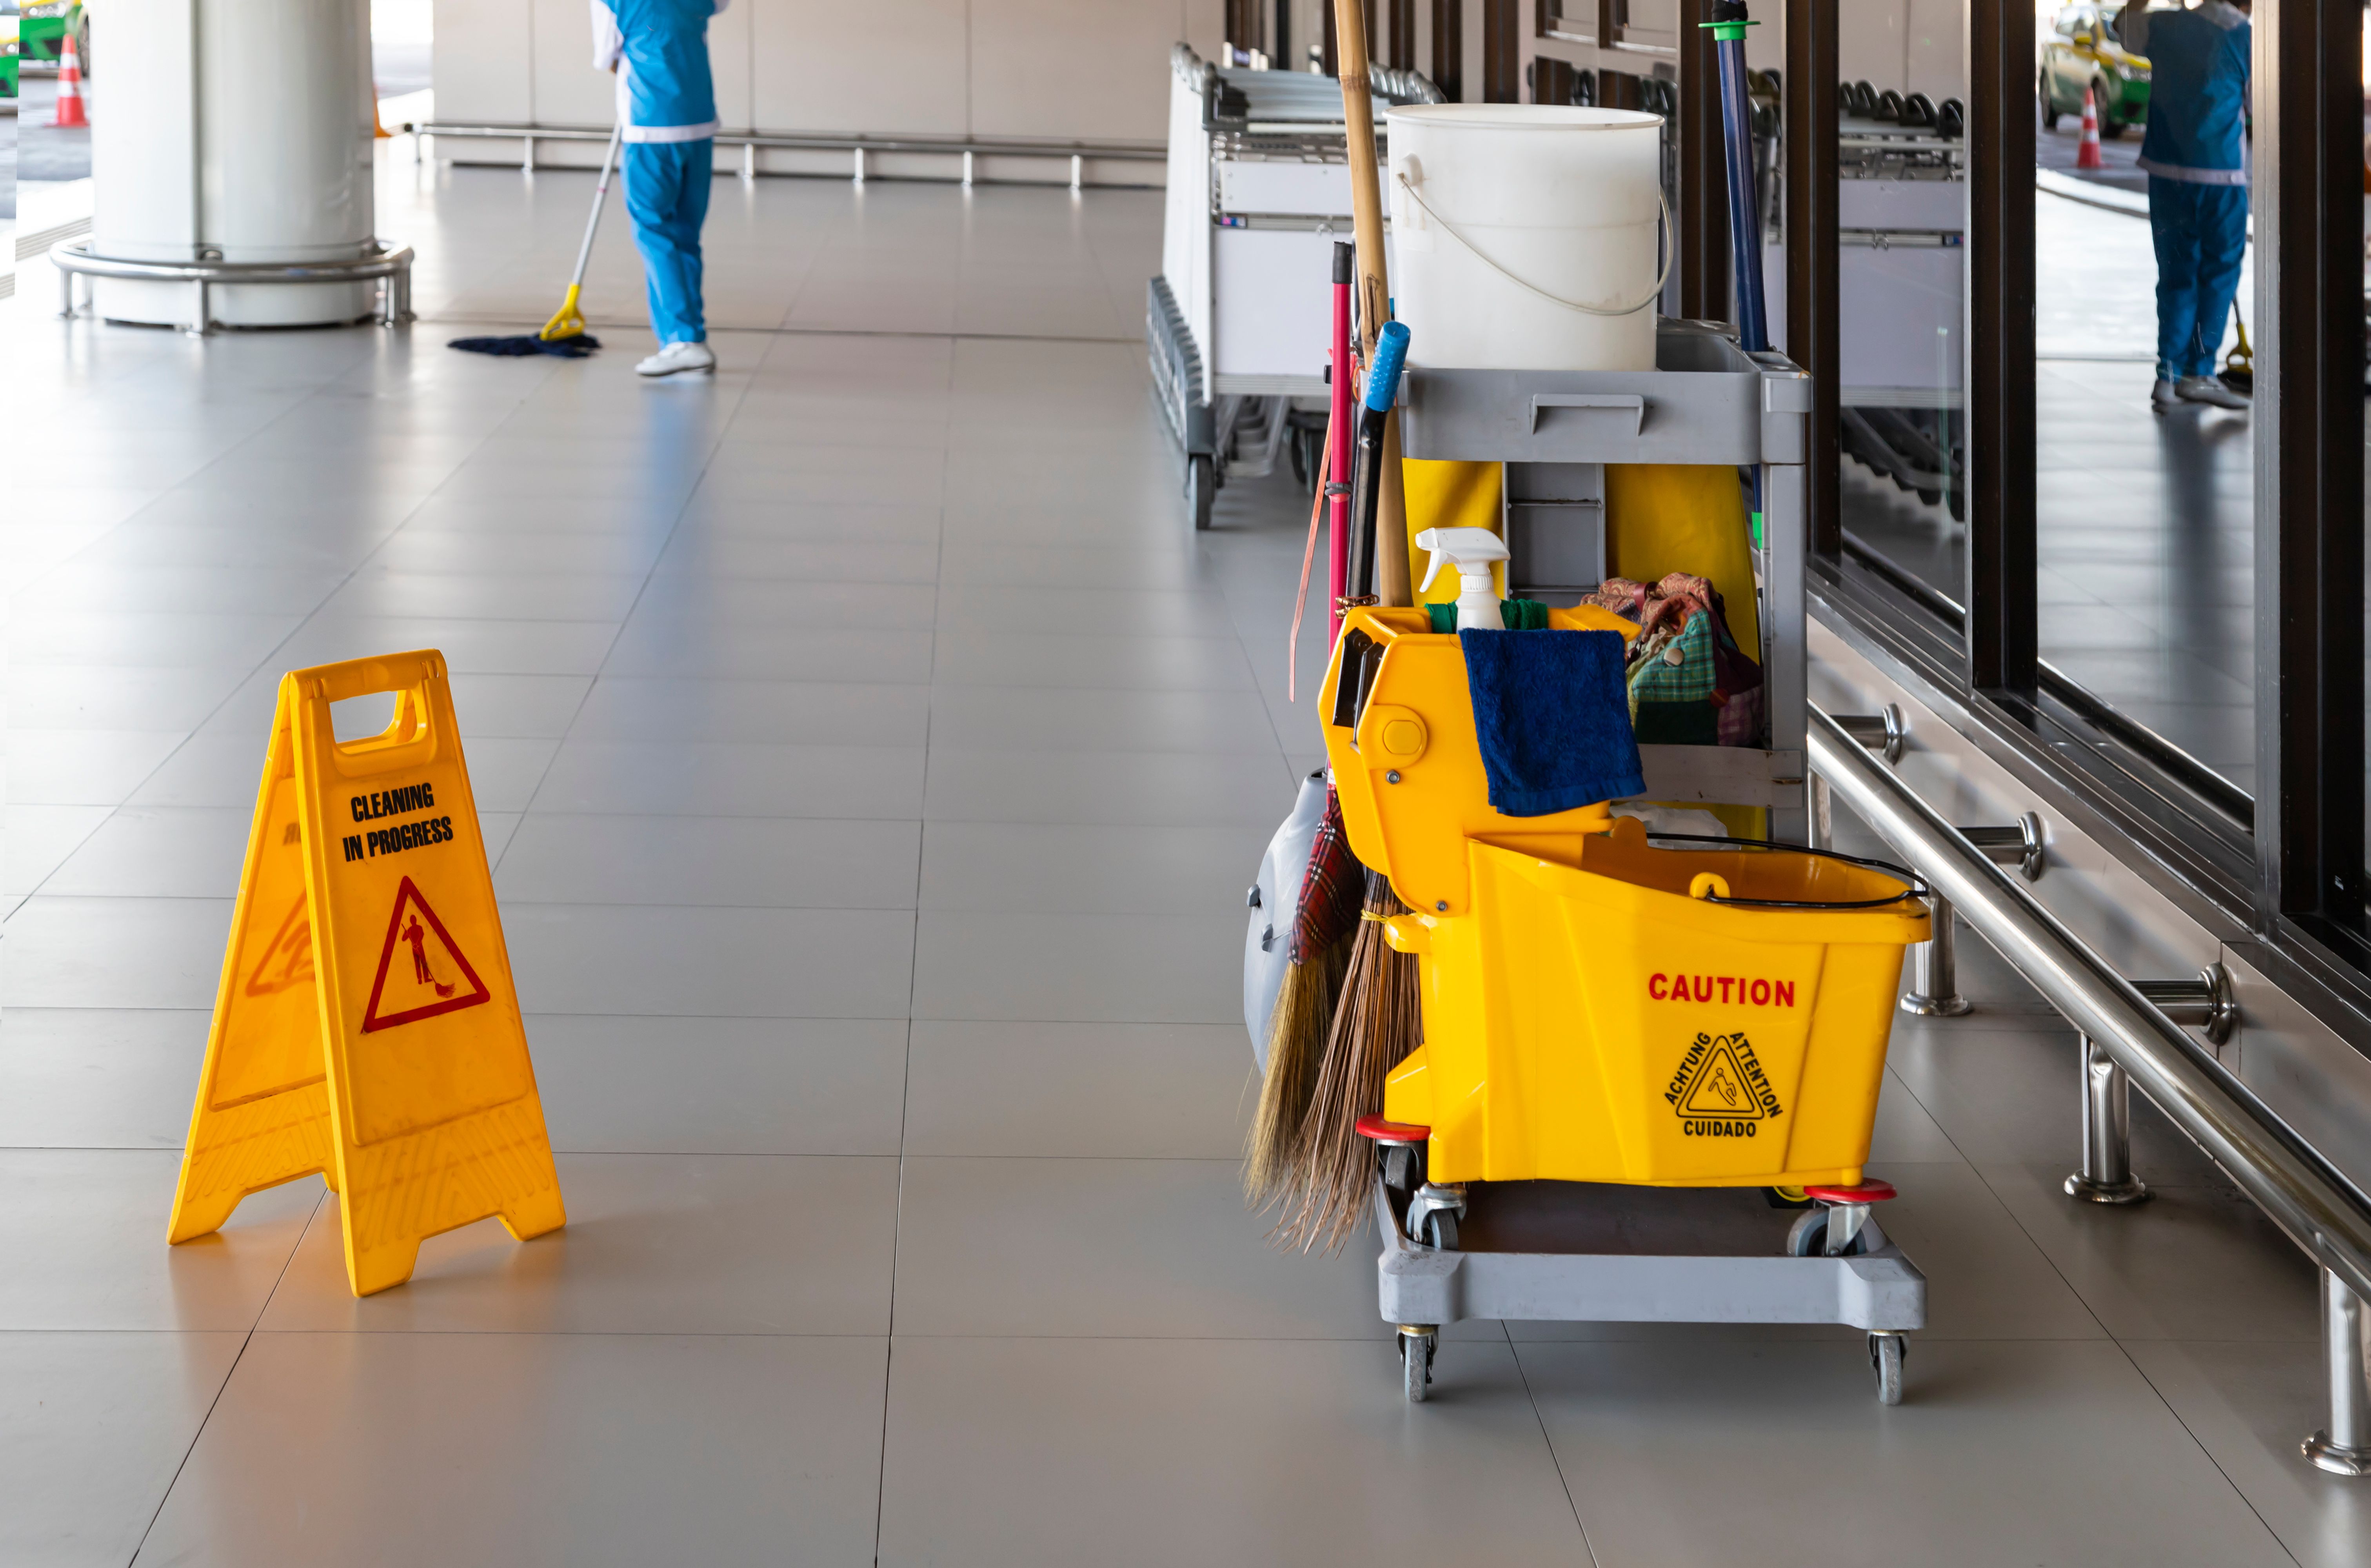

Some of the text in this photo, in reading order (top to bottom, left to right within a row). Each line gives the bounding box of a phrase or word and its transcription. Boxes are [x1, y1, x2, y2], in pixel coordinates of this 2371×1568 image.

[351, 782, 434, 822] CLEANING
[342, 816, 454, 862] IN PROGRESS
[1648, 973, 1795, 1007] CAUTION
[1664, 1032, 1711, 1106] ACHTUNG
[1730, 1032, 1783, 1118] ATTENTION
[1684, 1120, 1756, 1137] CUIDADO
